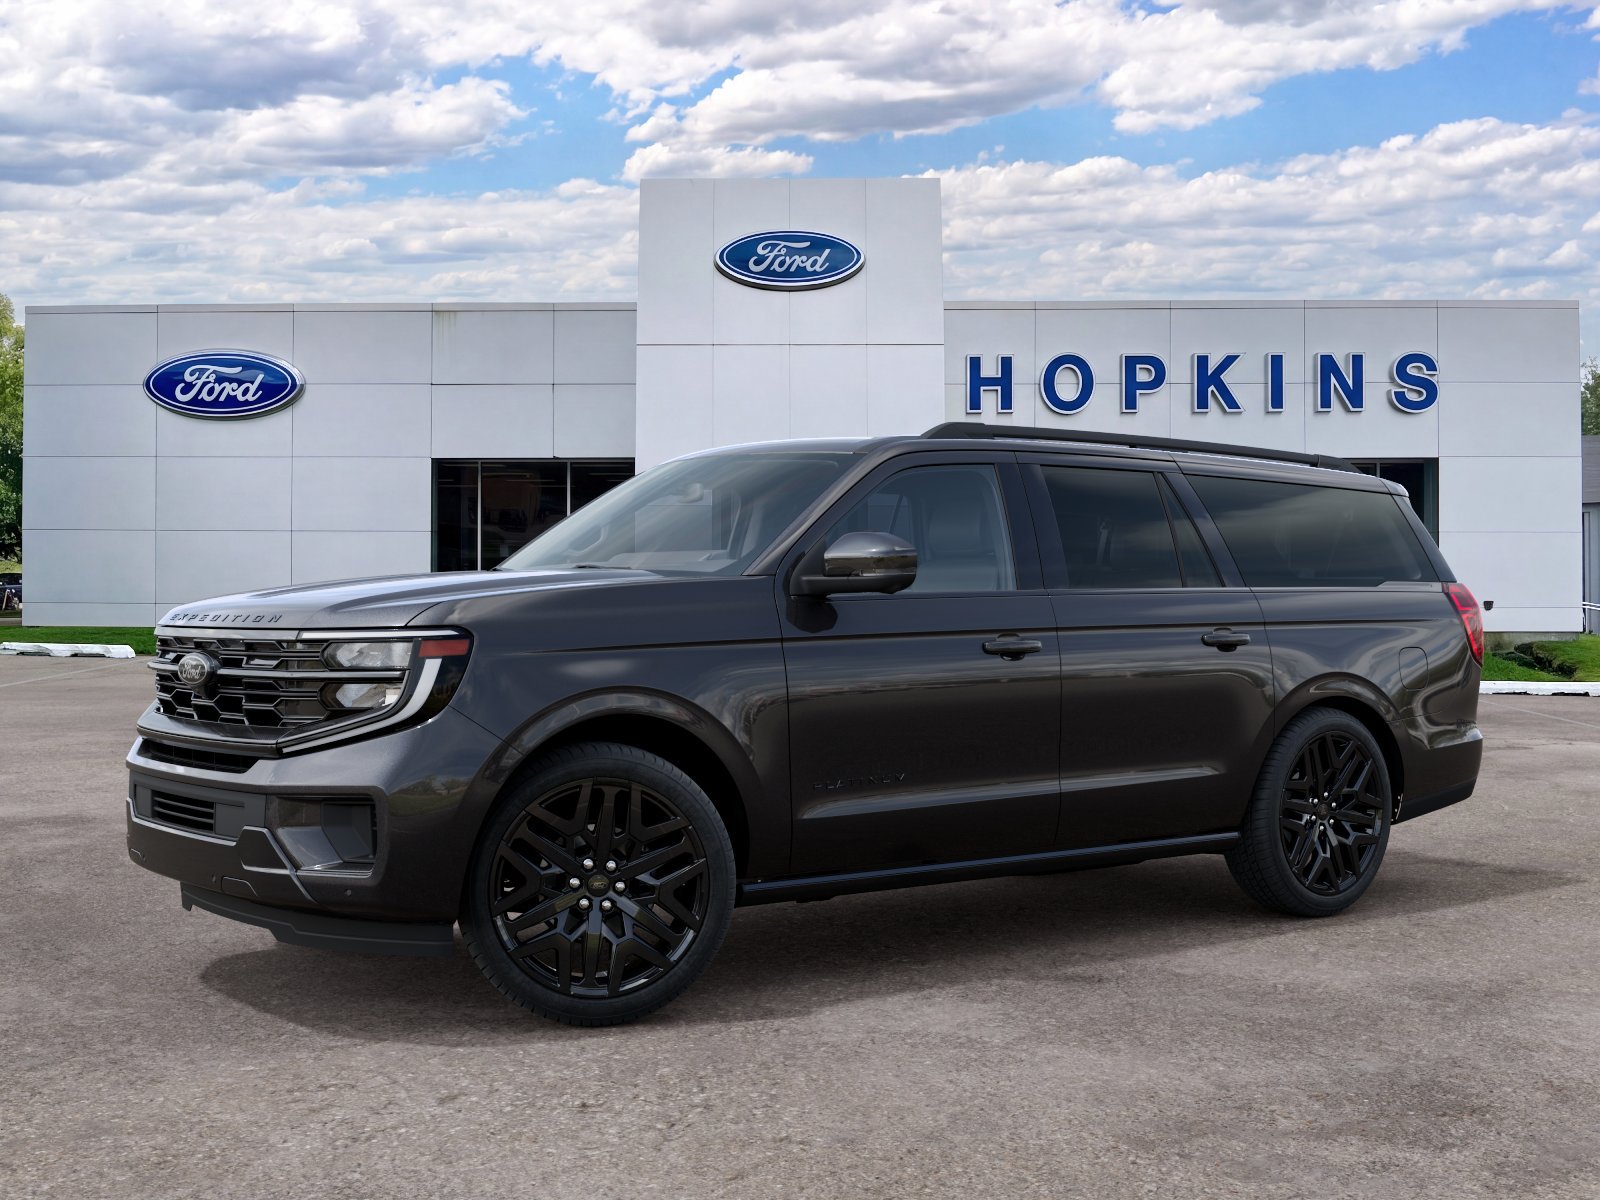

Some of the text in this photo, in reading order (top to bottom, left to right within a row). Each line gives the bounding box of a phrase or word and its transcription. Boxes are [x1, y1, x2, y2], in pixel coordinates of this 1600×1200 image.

[748, 240, 831, 272] Ford
[174, 364, 264, 402] Ford
[965, 351, 1440, 414] HOPKINS
[170, 613, 282, 623] EXPEDITION
